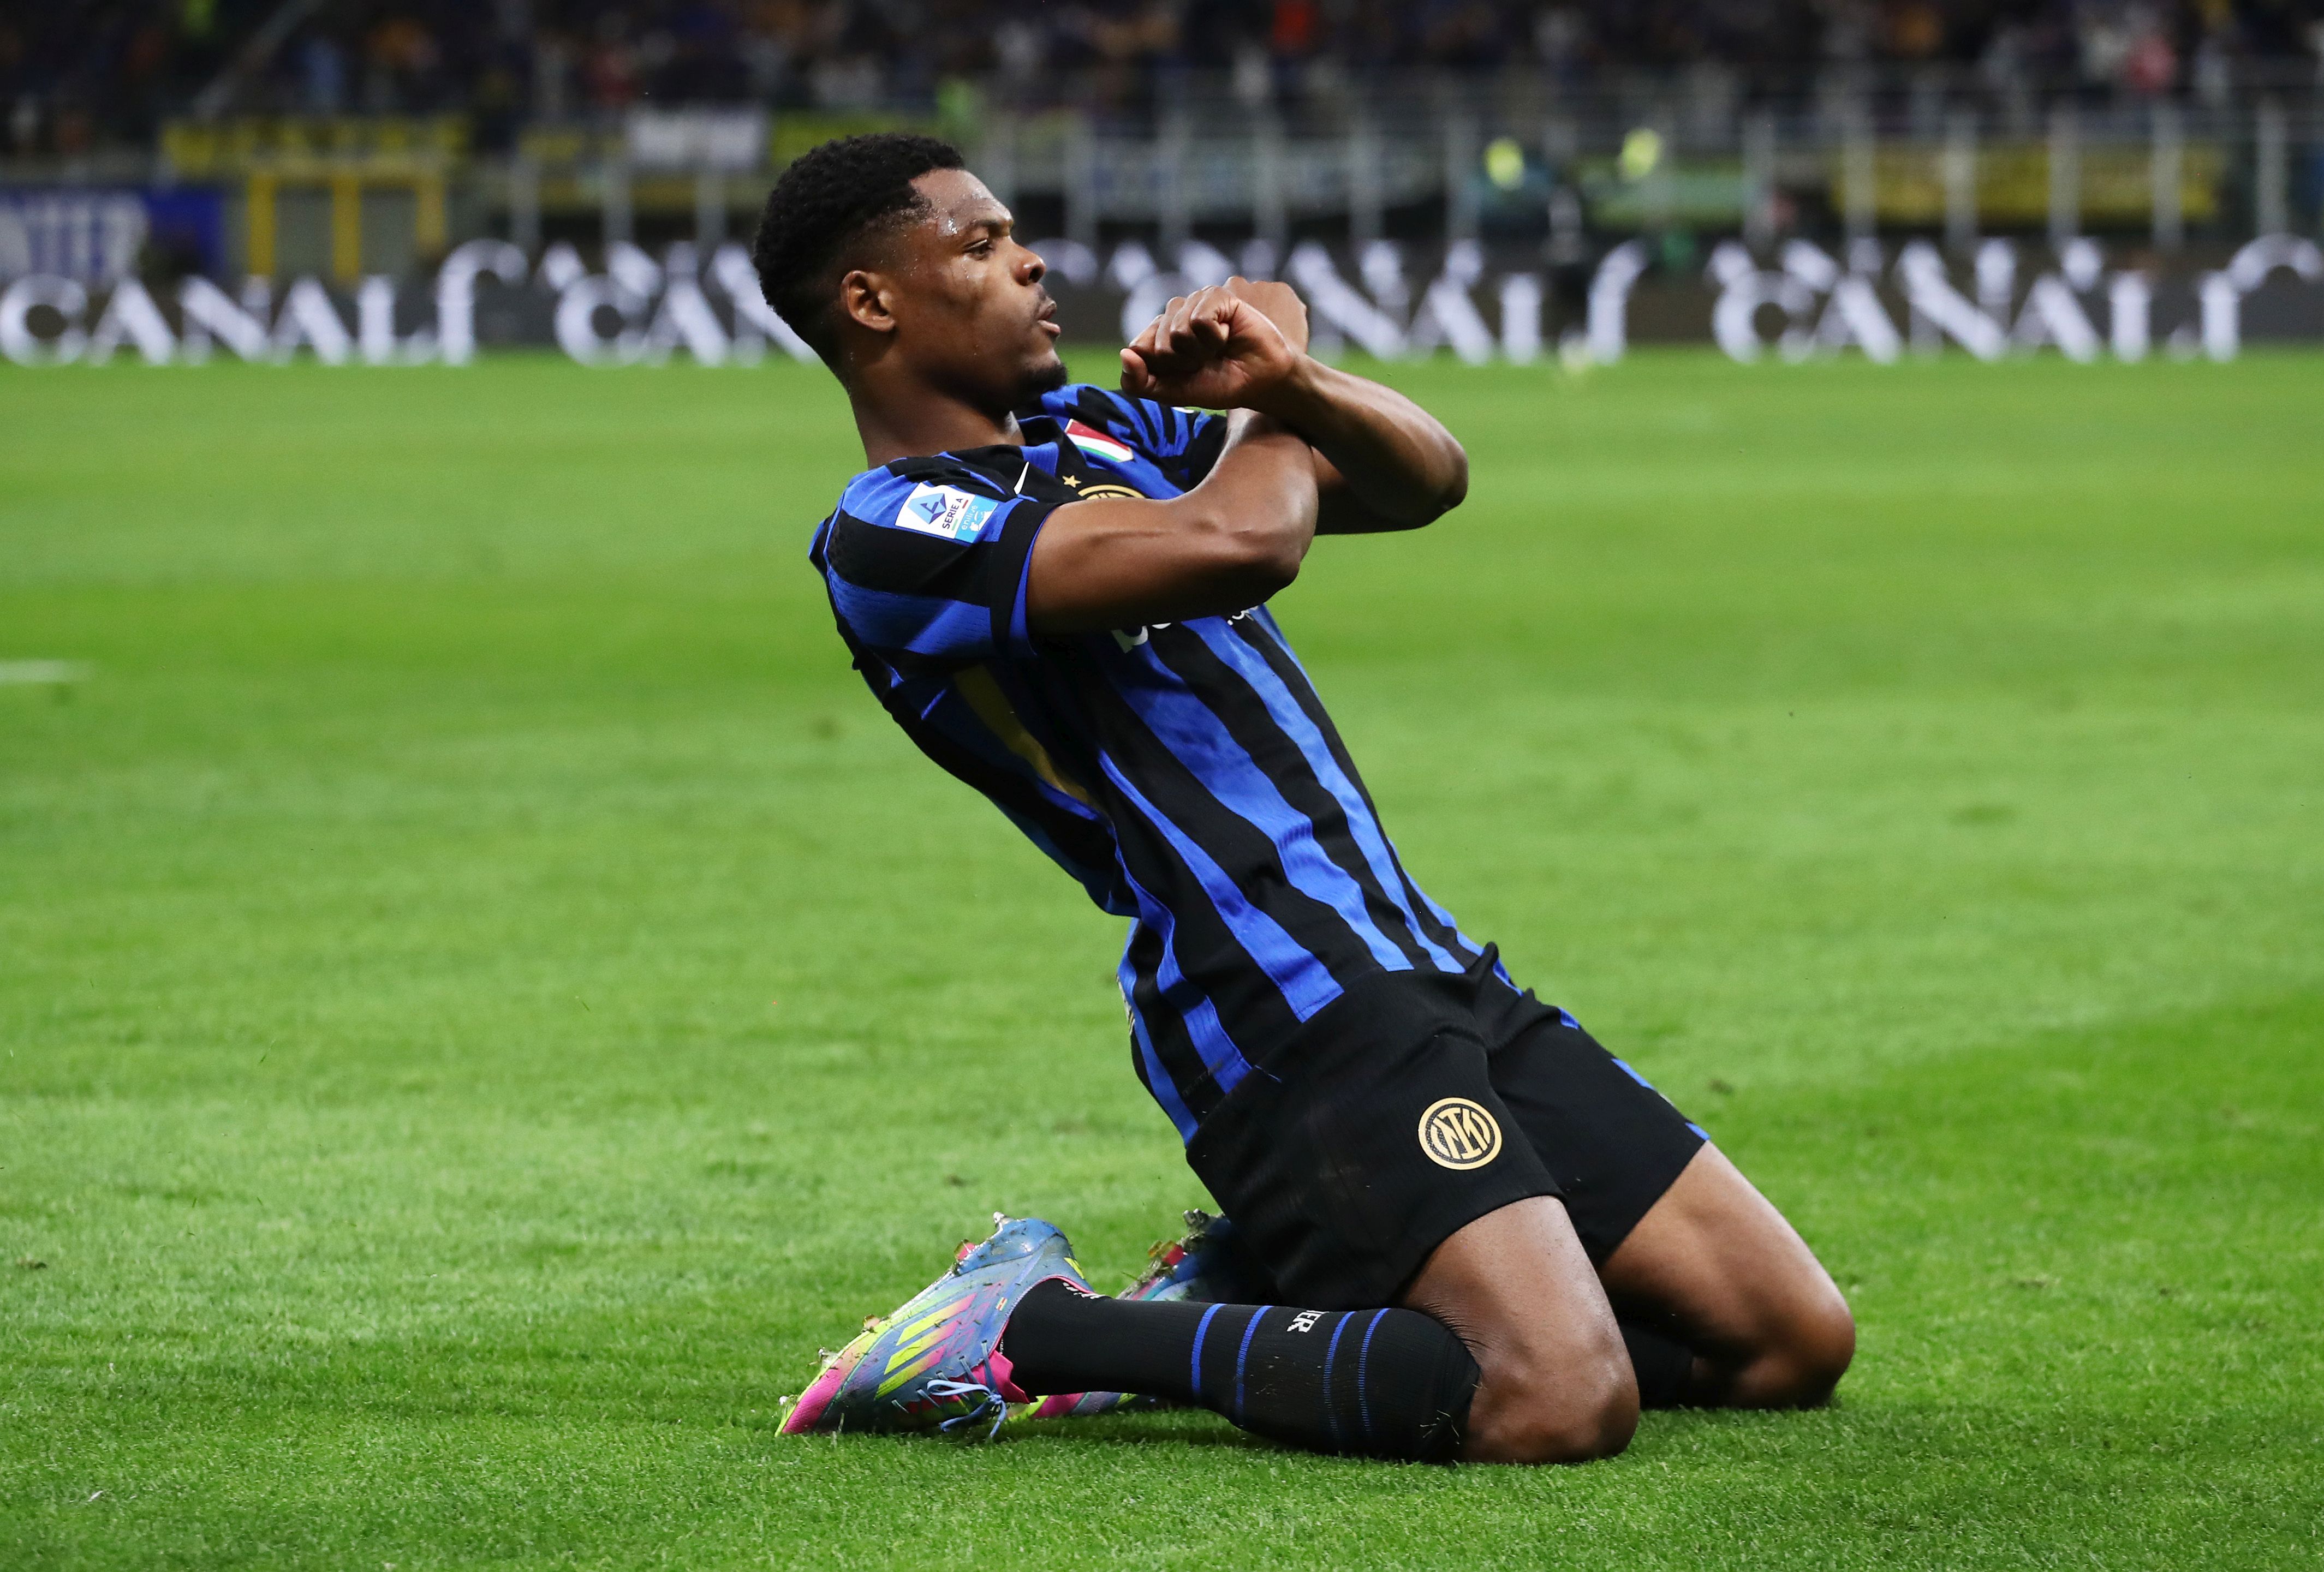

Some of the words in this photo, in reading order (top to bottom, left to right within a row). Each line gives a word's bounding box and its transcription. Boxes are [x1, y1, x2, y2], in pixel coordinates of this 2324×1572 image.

[0, 273, 476, 367] CANALI
[942, 504, 959, 529] SERIE
[961, 505, 978, 530] enilive
[1286, 1310, 1327, 1332] ER
